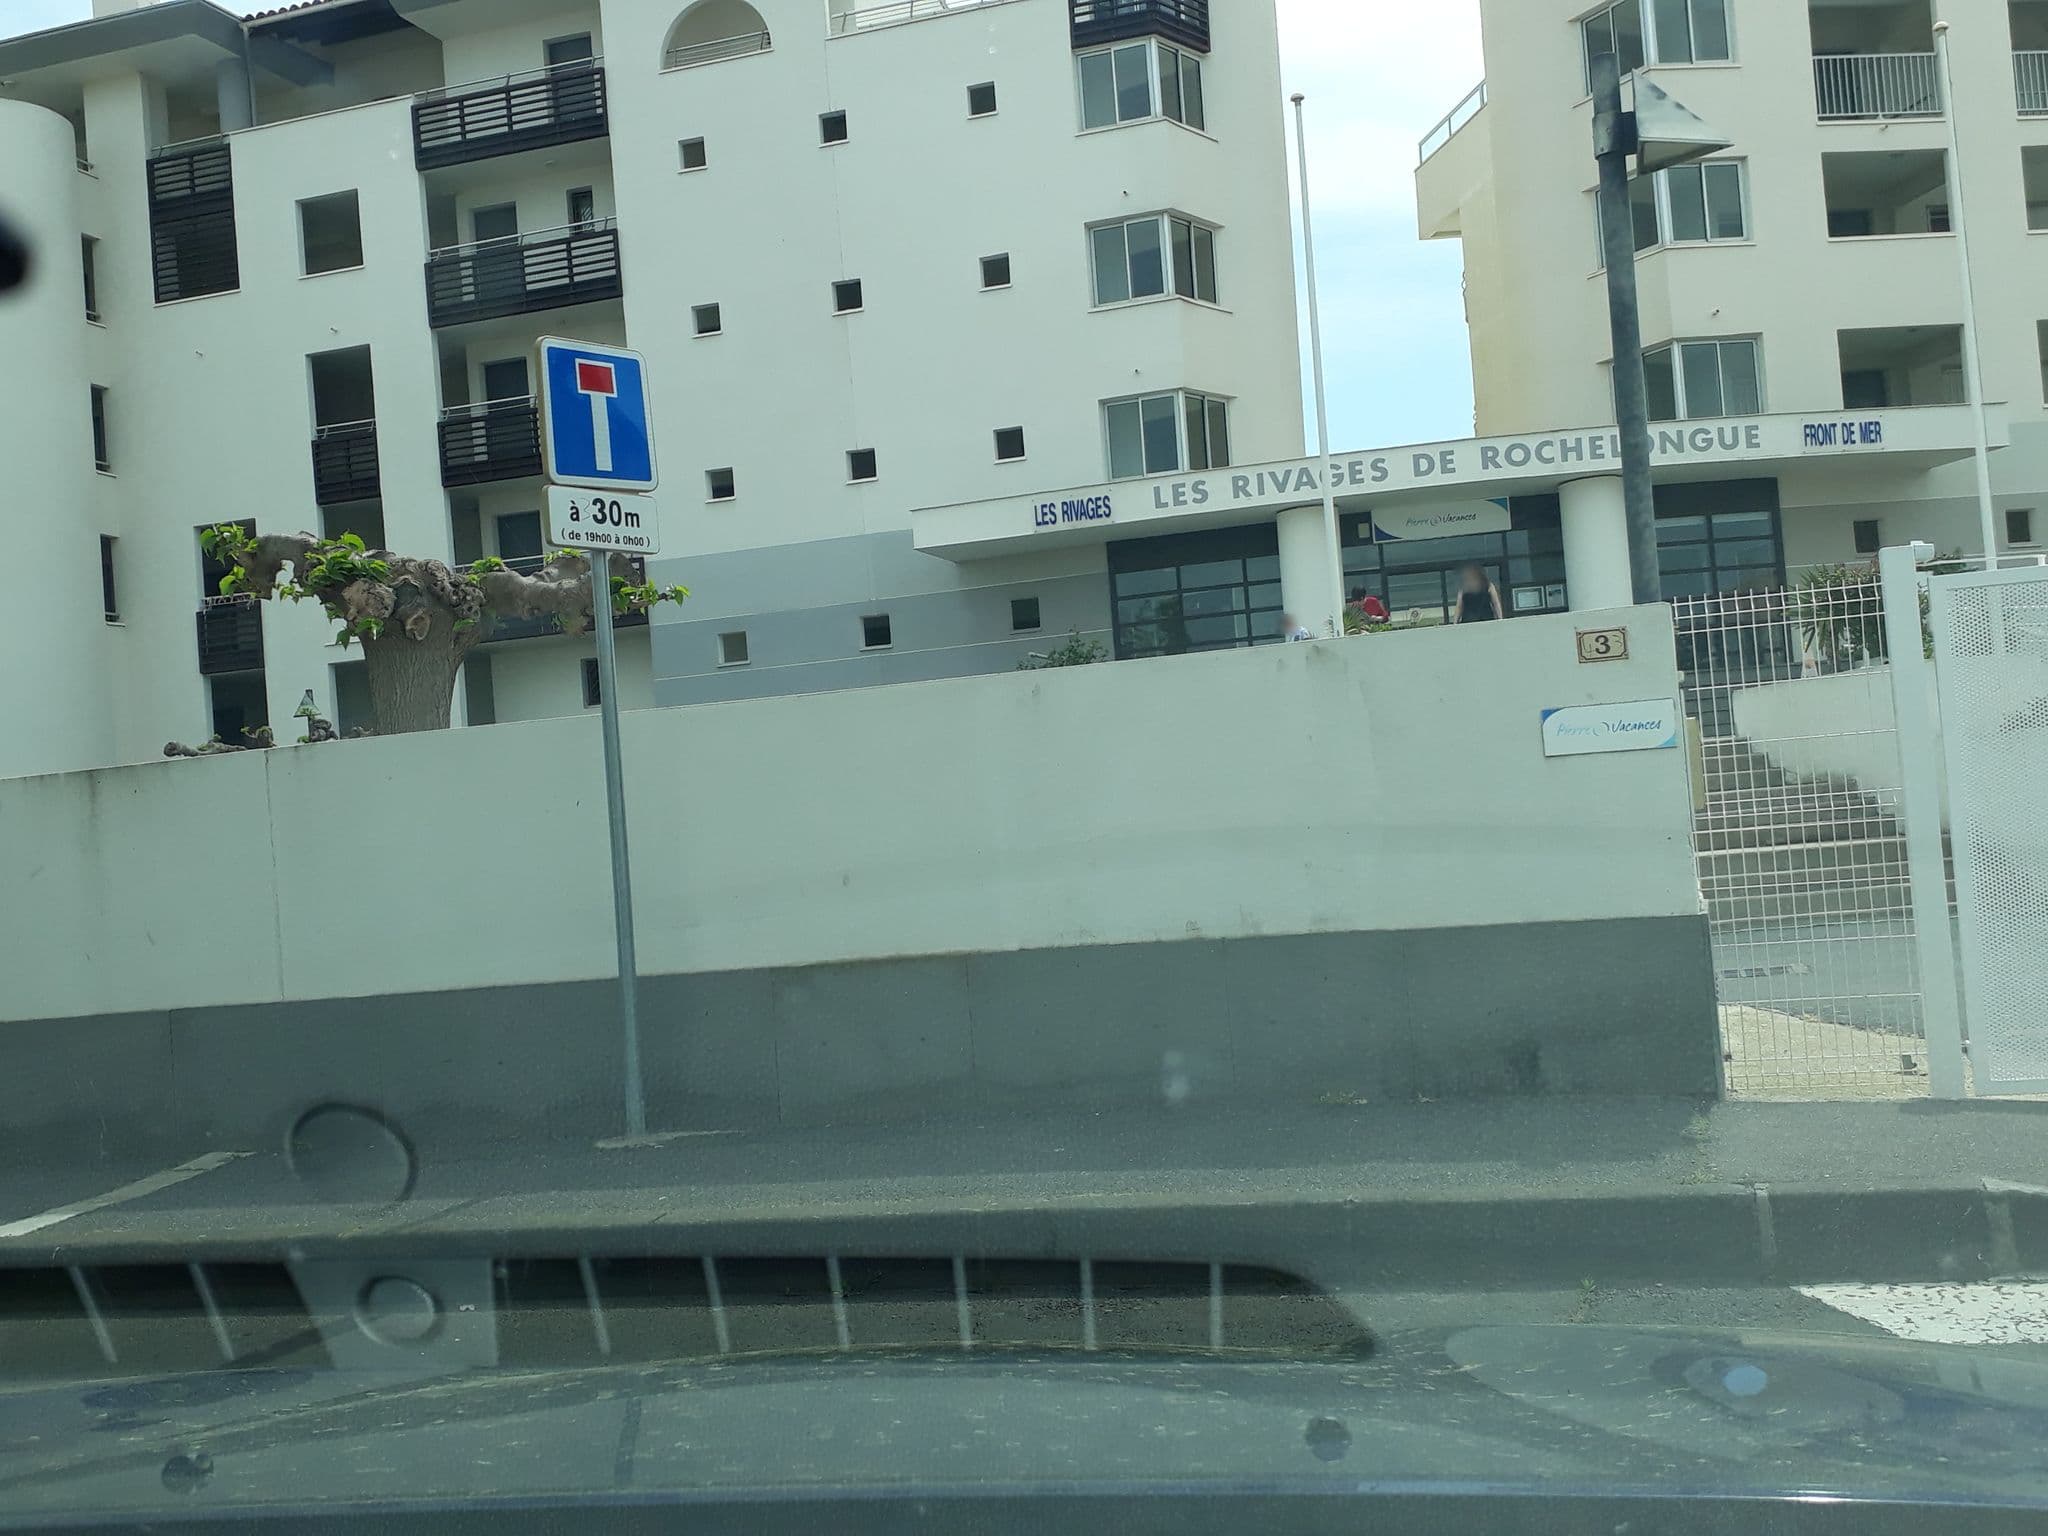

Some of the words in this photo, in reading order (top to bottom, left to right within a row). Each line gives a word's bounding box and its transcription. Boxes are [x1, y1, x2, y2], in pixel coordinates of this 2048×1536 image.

[1803, 422, 1838, 447] FRONT
[1841, 422, 1856, 445] DE
[1859, 421, 1882, 444] MER
[1153, 479, 1209, 509] LES
[1412, 449, 1456, 478] DE
[1480, 424, 1761, 471] ROCHELNGUE
[569, 499, 580, 522] à
[1034, 502, 1057, 527] LES
[1061, 495, 1112, 523] RIVAGES
[585, 531, 612, 544] 19h00
[614, 533, 620, 545] à
[1595, 634, 1610, 655] 3
[1611, 719, 1662, 734] Vacances
